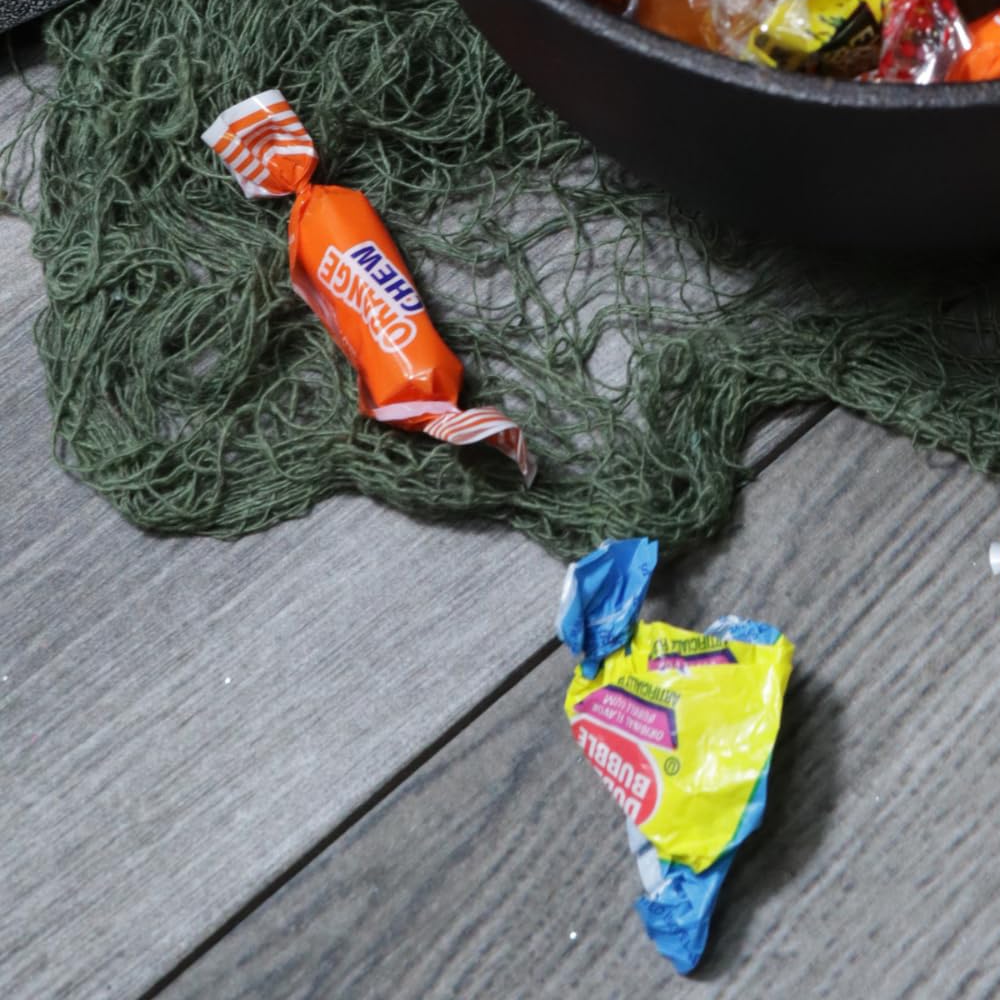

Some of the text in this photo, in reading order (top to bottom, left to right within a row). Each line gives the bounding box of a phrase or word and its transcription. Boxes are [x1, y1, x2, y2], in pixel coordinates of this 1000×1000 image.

[319, 249, 415, 352] ORANGE
[351, 245, 424, 311] CHEW
[577, 726, 650, 796] BUBBLE
